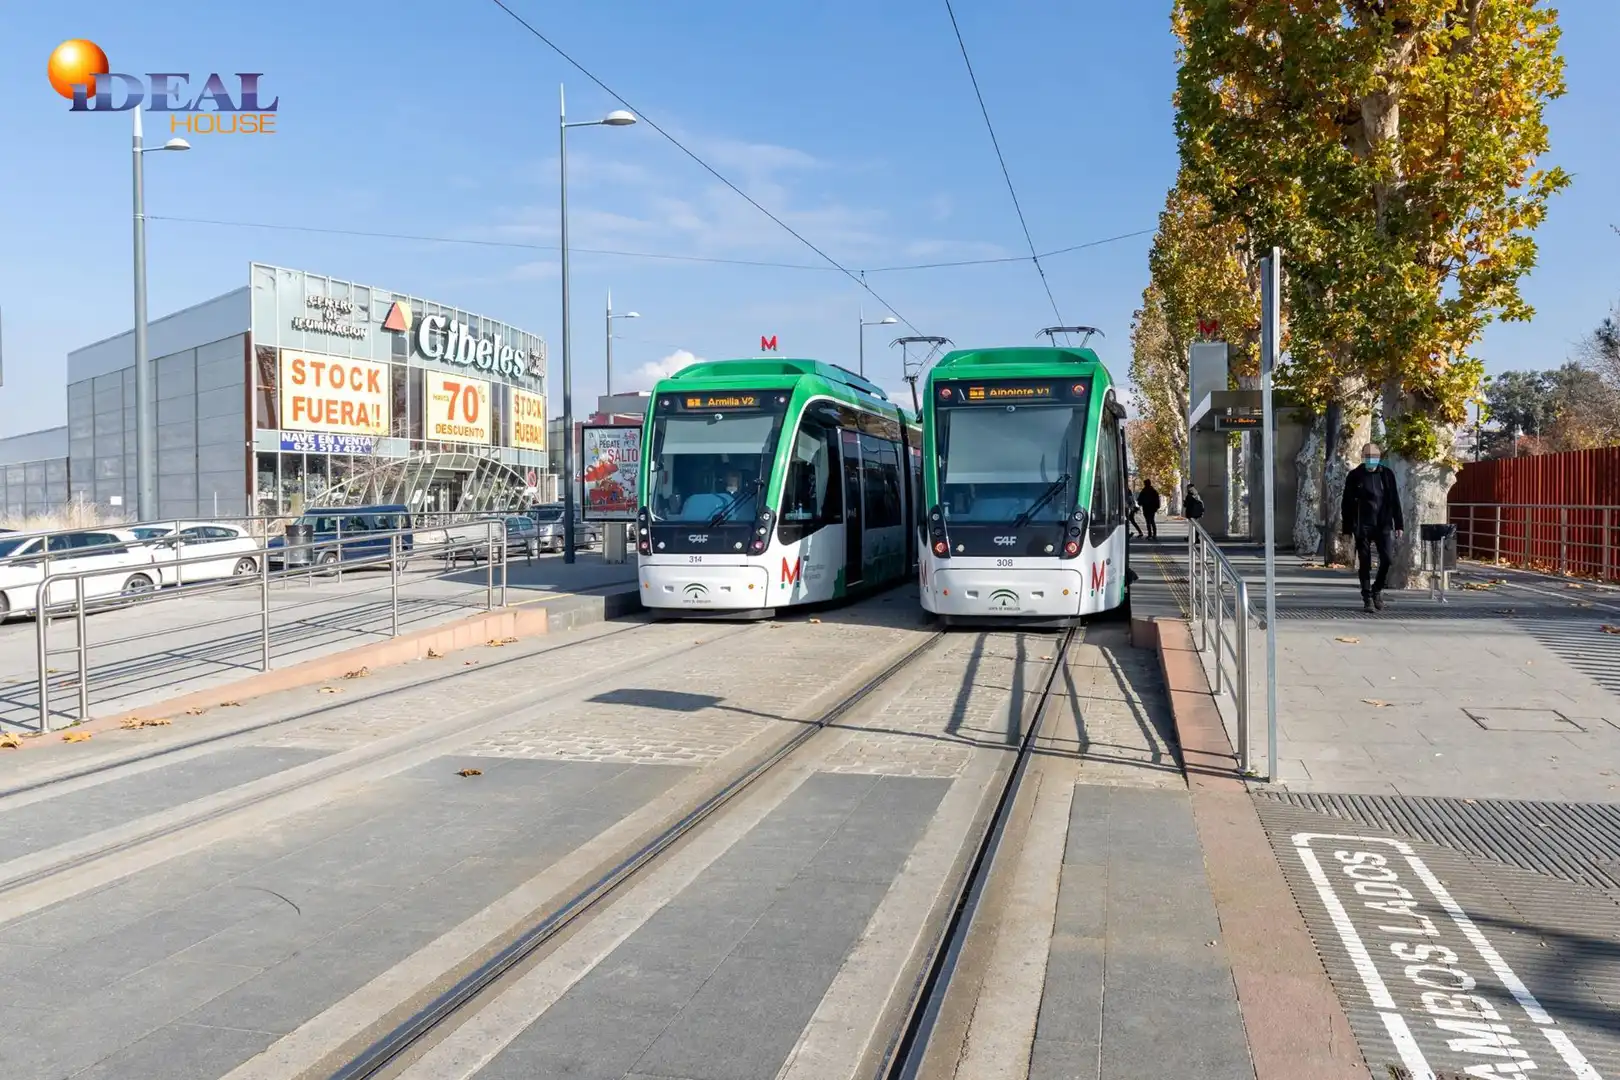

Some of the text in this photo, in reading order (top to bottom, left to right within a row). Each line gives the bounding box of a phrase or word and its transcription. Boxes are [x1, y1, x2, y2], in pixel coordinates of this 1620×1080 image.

[418, 314, 525, 378] Cibeles
[761, 335, 777, 351] M
[291, 358, 380, 393] STOCK
[514, 393, 541, 419] STOCK
[708, 397, 739, 406] Armilla
[742, 396, 754, 405] V2
[281, 432, 371, 446] NAVE EN VENTA
[435, 423, 485, 439] DESCUENTO
[293, 442, 316, 452] 622
[607, 448, 638, 464] SALTO
[688, 534, 708, 543] CAF
[993, 536, 1017, 546] CAF
[996, 559, 1013, 567] 308
[781, 556, 800, 589] M
[1090, 560, 1105, 597] M
[1334, 850, 1440, 937] LADOS
